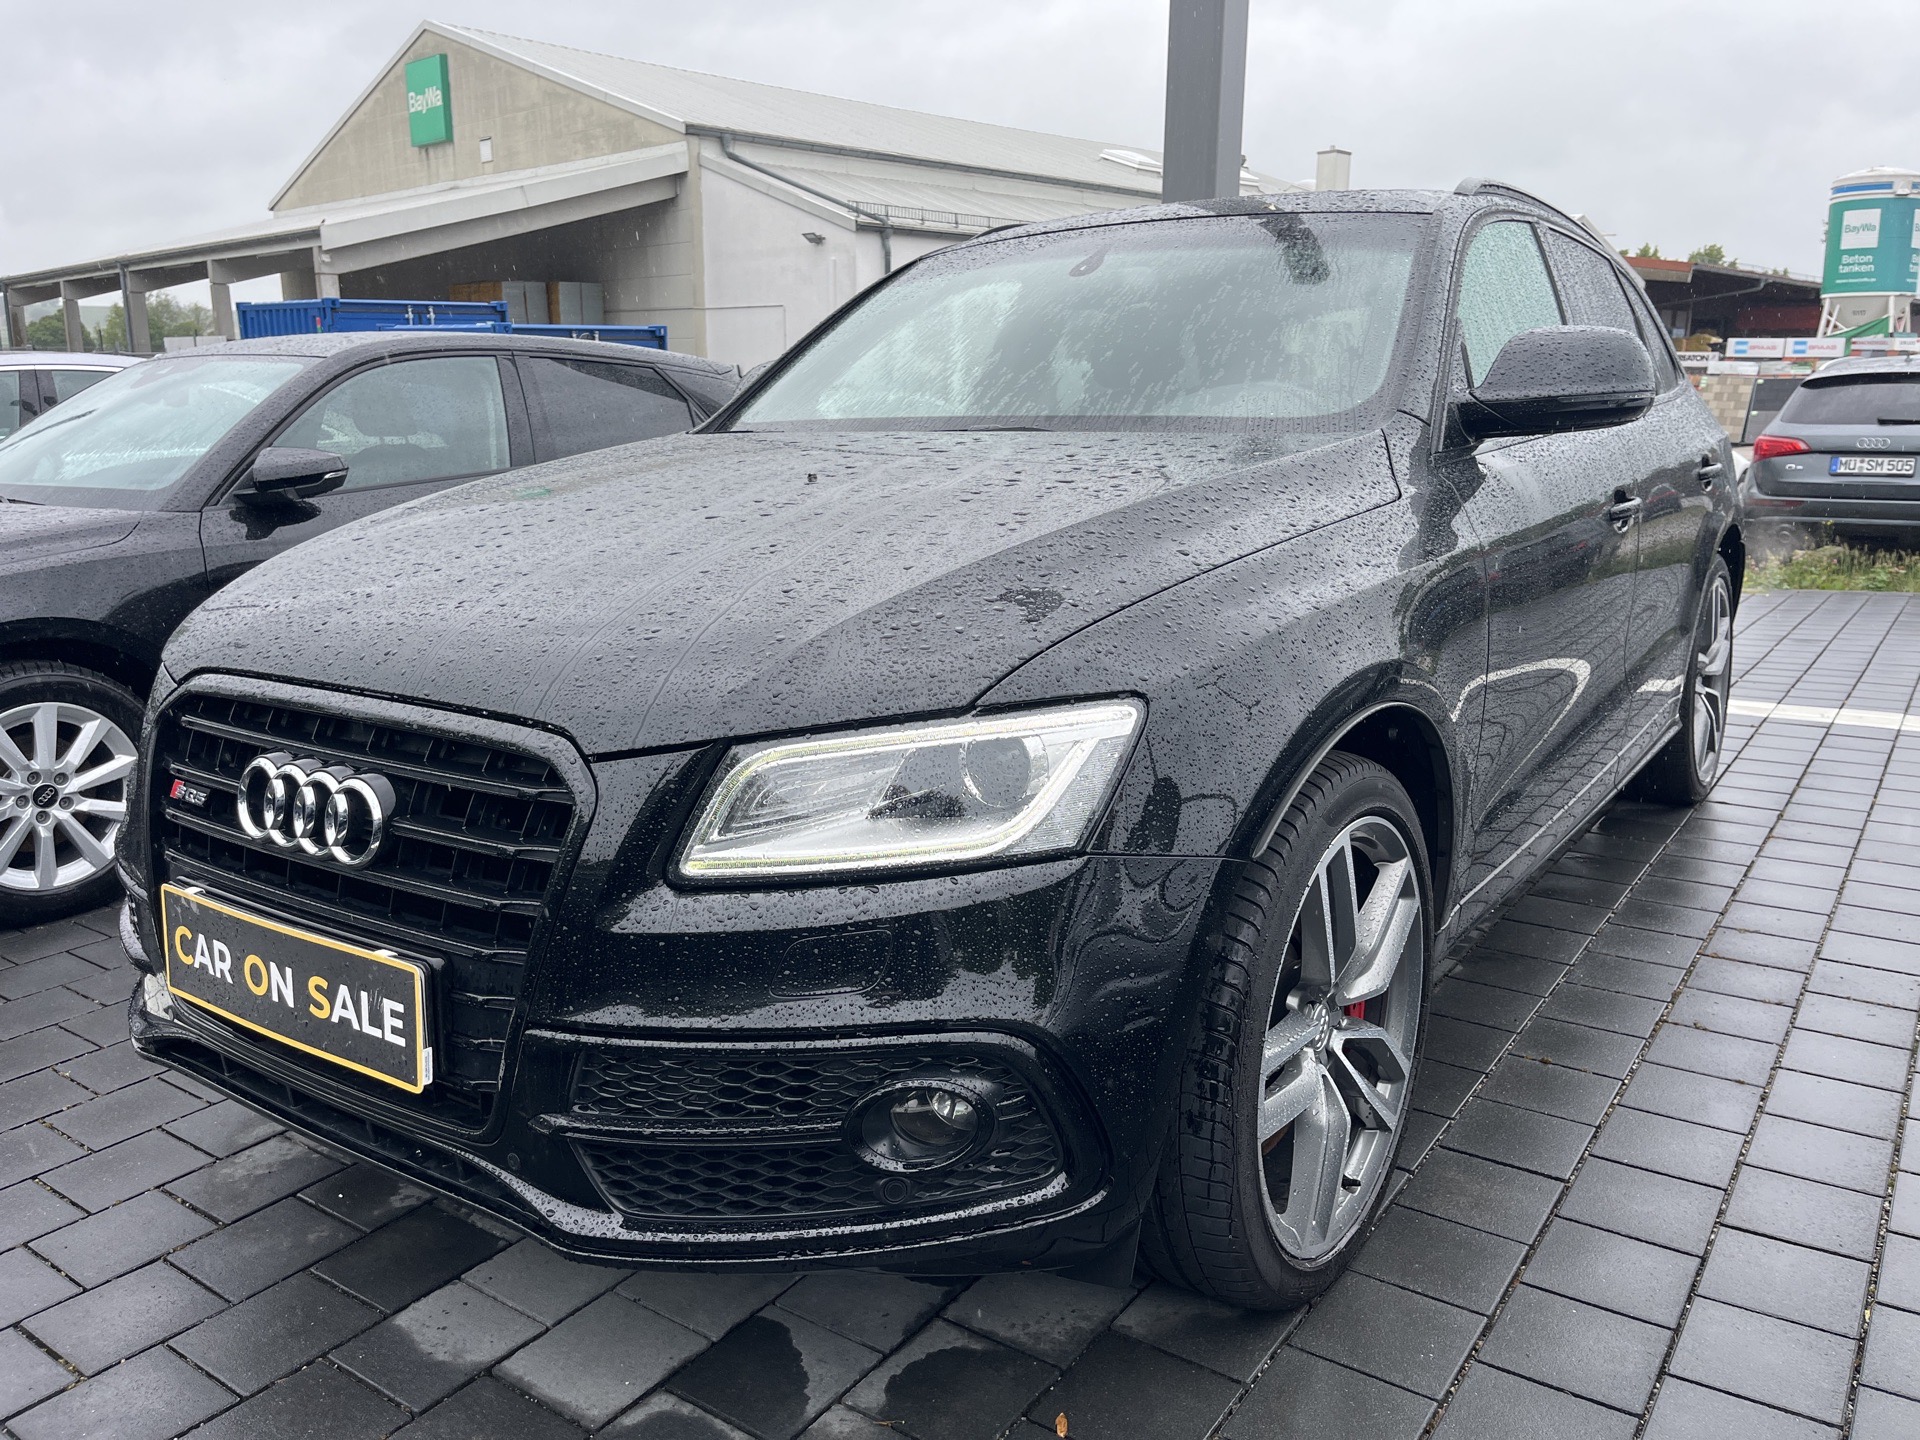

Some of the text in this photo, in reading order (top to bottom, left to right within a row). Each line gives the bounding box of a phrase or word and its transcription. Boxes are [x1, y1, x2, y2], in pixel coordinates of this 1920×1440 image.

[408, 86, 443, 114] BayWa
[1844, 223, 1877, 234] BayWa
[1841, 255, 1873, 264] Beton
[1838, 264, 1875, 273] tanken
[1866, 459, 1884, 471] SM
[1887, 460, 1914, 472] 505
[174, 925, 406, 1048] CAR ON SALE
